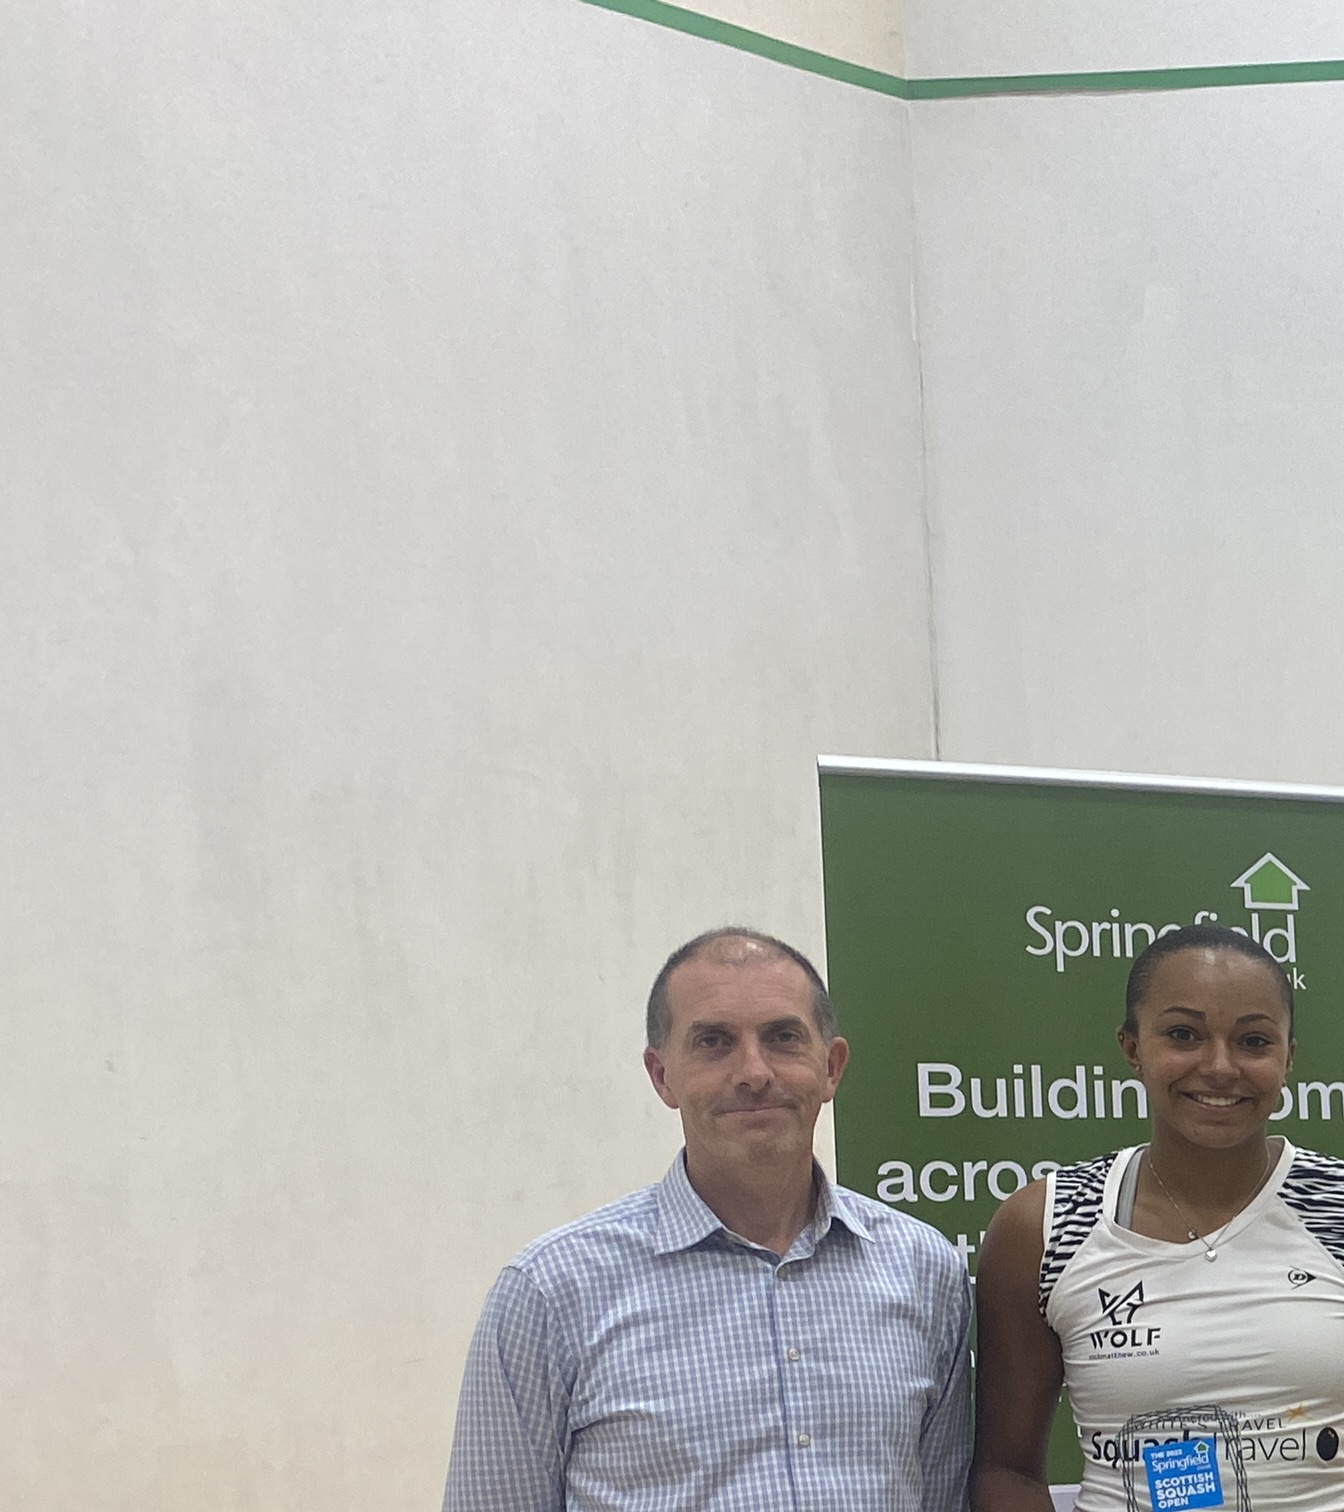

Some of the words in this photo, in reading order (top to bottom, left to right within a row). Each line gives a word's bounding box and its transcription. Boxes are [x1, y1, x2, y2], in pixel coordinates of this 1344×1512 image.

[917, 1062, 1148, 1119] Buildin
[1090, 1327, 1162, 1349] WOLF
[1152, 1453, 1209, 1474] Springfield
[1155, 1471, 1214, 1489] SCOTTISH
[1156, 1482, 1216, 1500] SQUASH
[1158, 1497, 1189, 1509] OPEN
